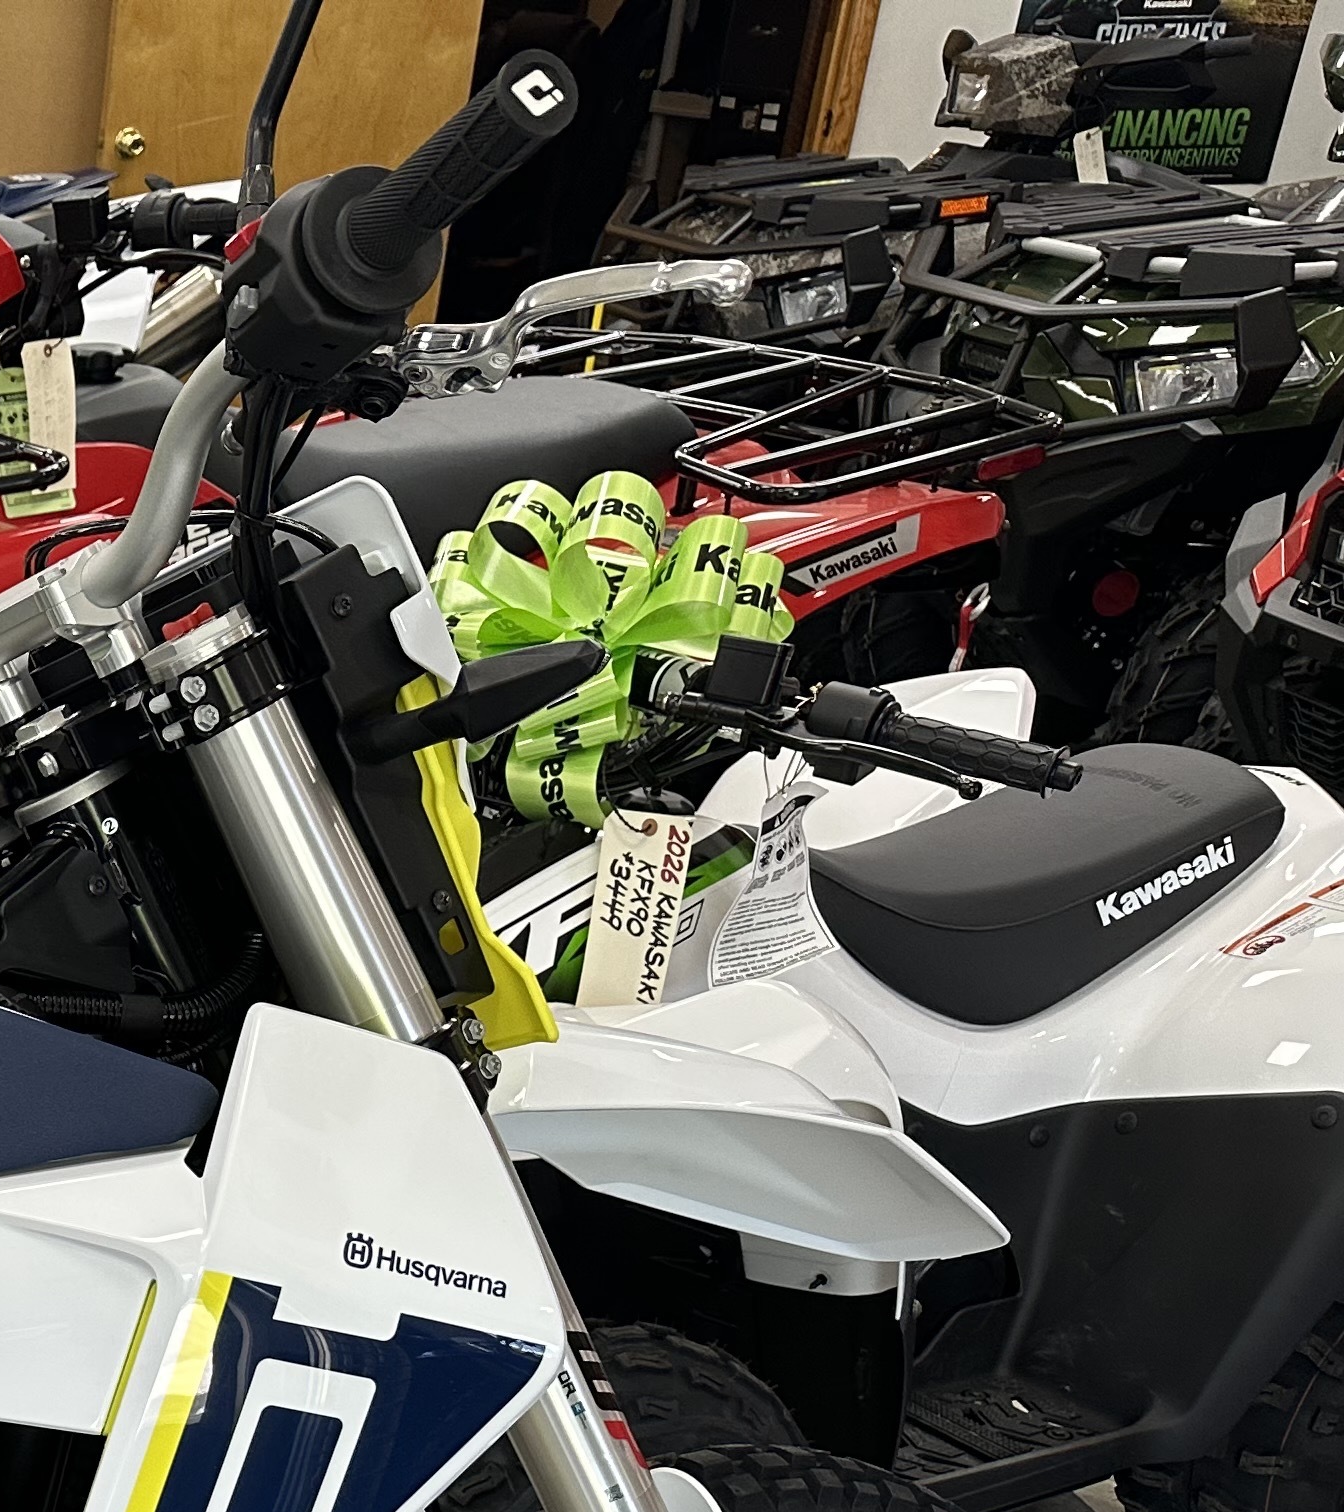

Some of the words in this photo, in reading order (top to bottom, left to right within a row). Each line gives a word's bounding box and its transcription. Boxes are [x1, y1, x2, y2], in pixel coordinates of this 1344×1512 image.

[1161, 147, 1241, 167] INCENTIVES
[808, 536, 899, 585] Kawasaki
[661, 824, 690, 886] 2026
[1095, 835, 1236, 927] Kawasaki
[599, 851, 635, 932] $3449
[625, 858, 659, 938] KFX90
[635, 890, 678, 1005] KAWASAKI
[375, 1246, 508, 1299] Husqvarna
